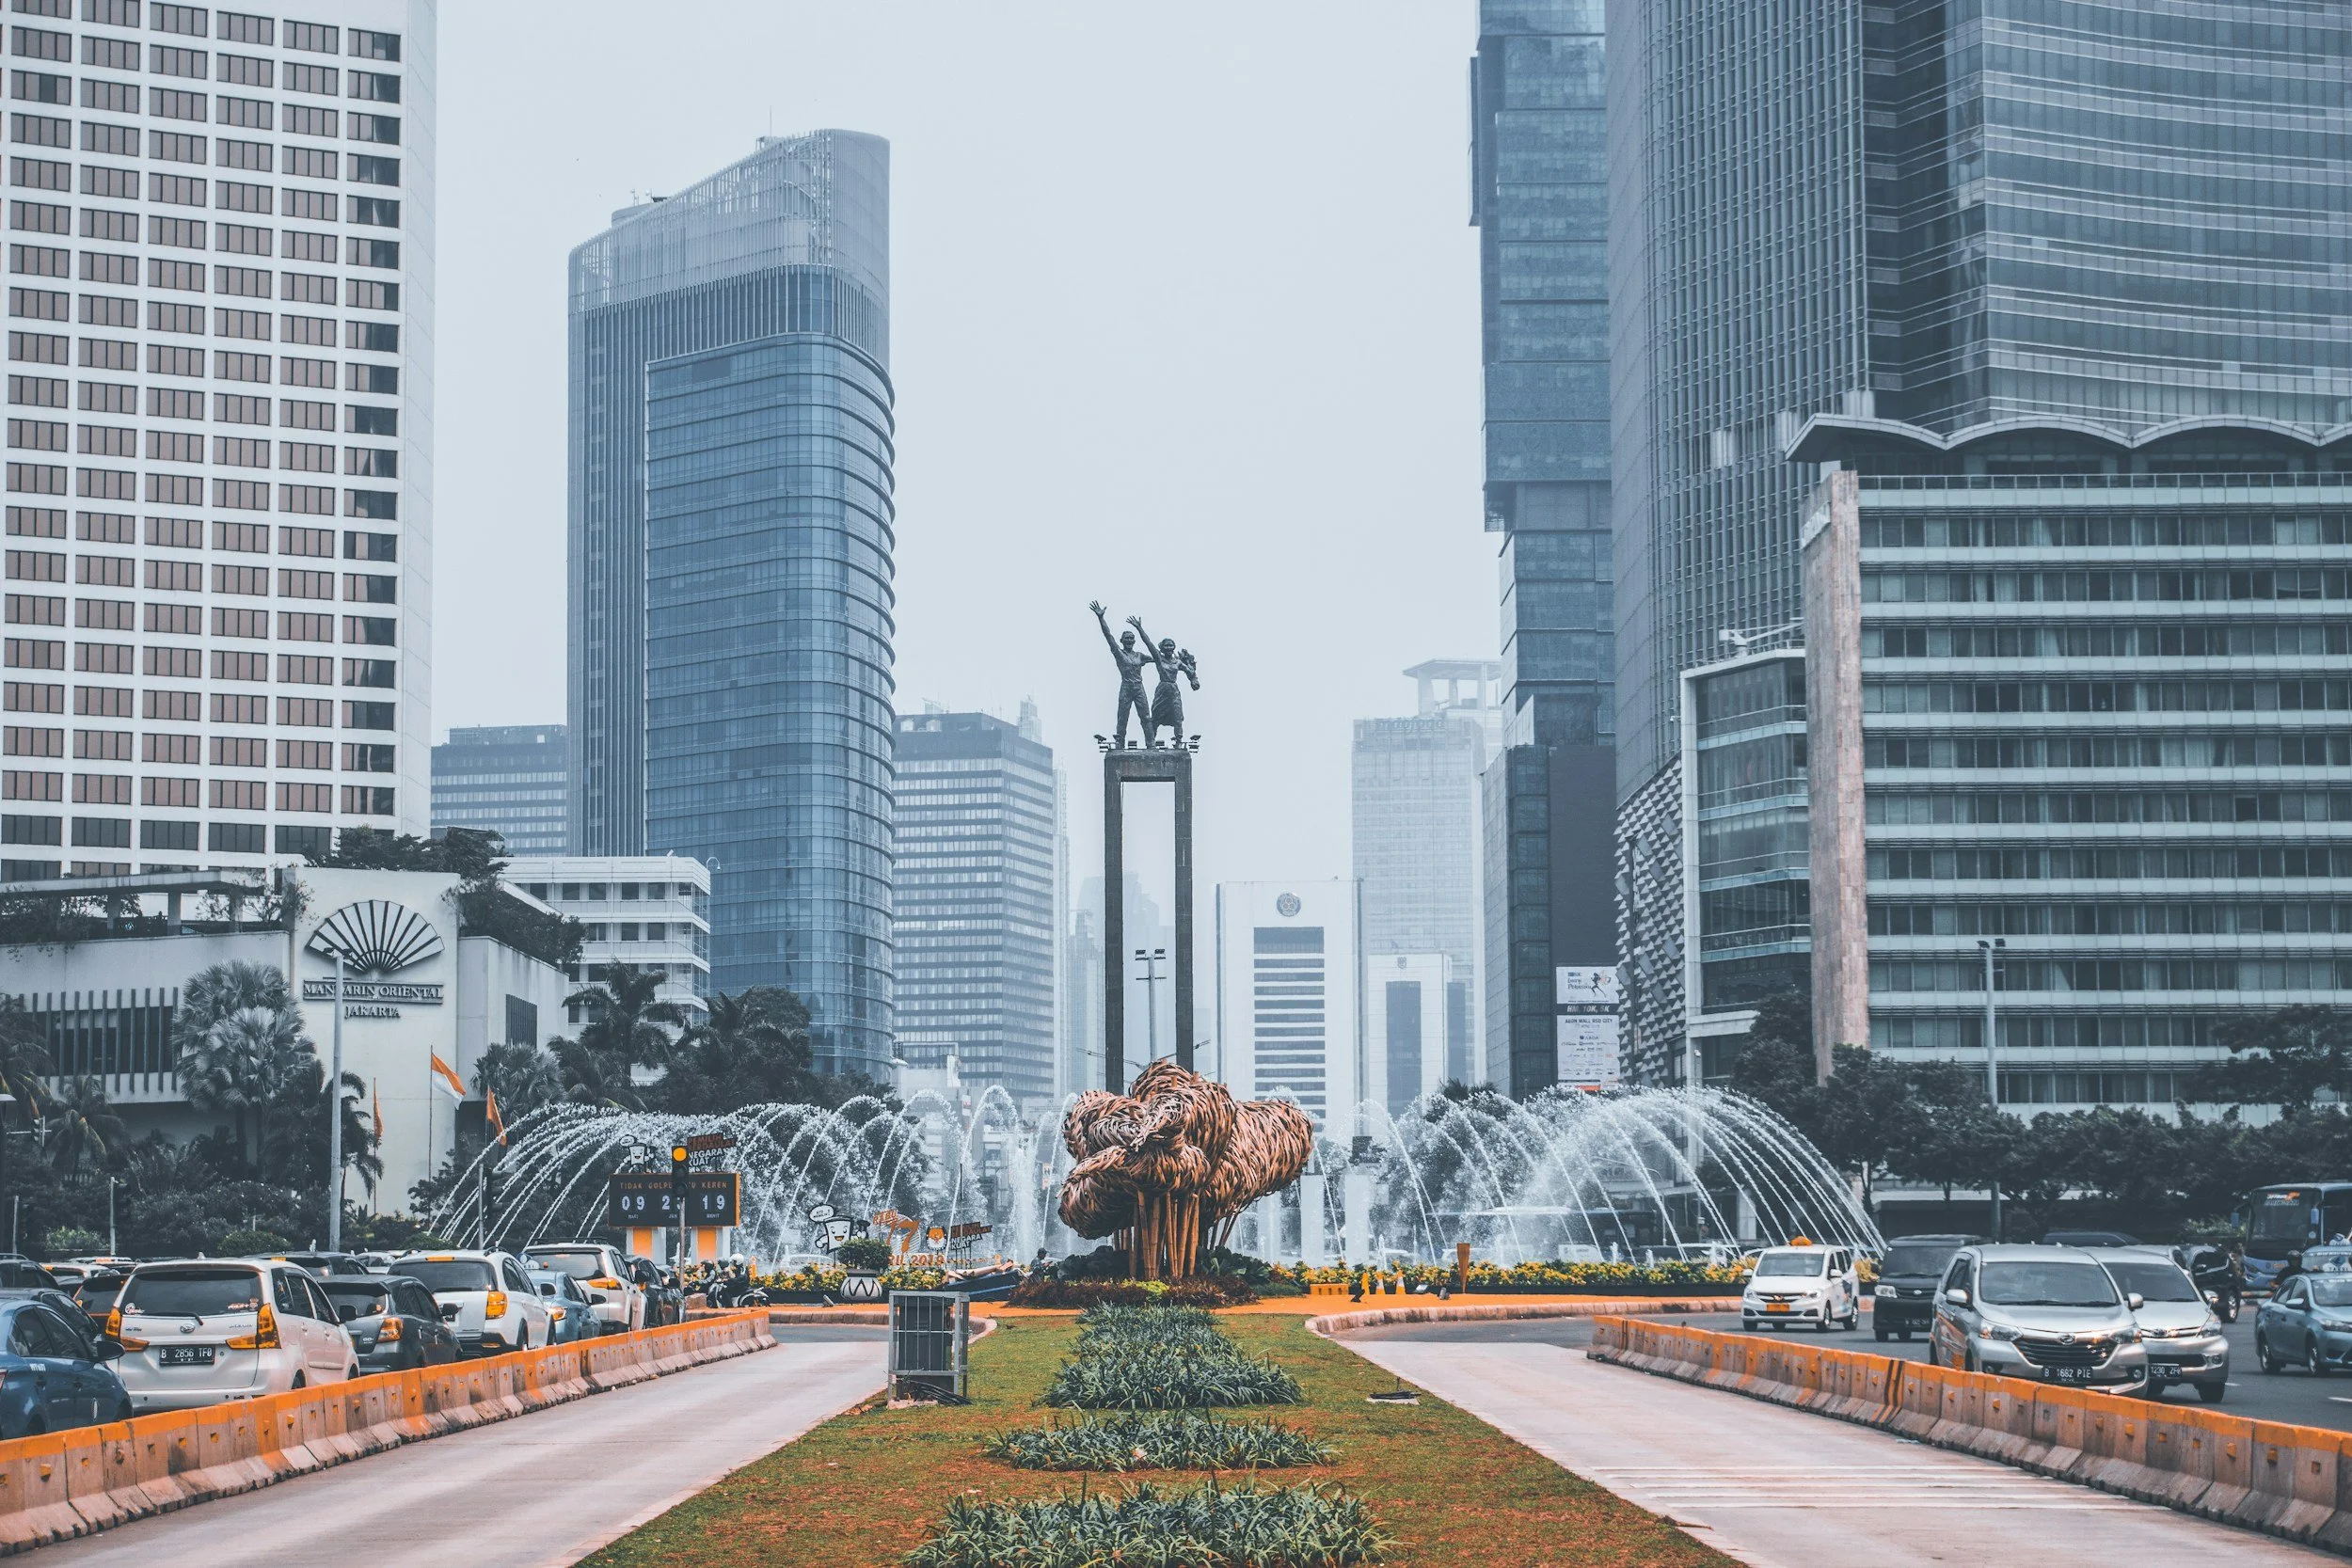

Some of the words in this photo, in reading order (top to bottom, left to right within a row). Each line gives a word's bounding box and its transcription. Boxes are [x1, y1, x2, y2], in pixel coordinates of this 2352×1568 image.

[304, 983, 377, 997] MANARIN
[379, 985, 444, 999] ORIENTAL
[344, 1006, 401, 1019] JAKARTA
[648, 1181, 673, 1190] GOLPU
[701, 1180, 727, 1189] KEREN
[951, 1233, 981, 1244] NEGARA
[951, 1241, 972, 1250] KUAT
[161, 1349, 167, 1359] B
[2076, 1369, 2091, 1379] PIE
